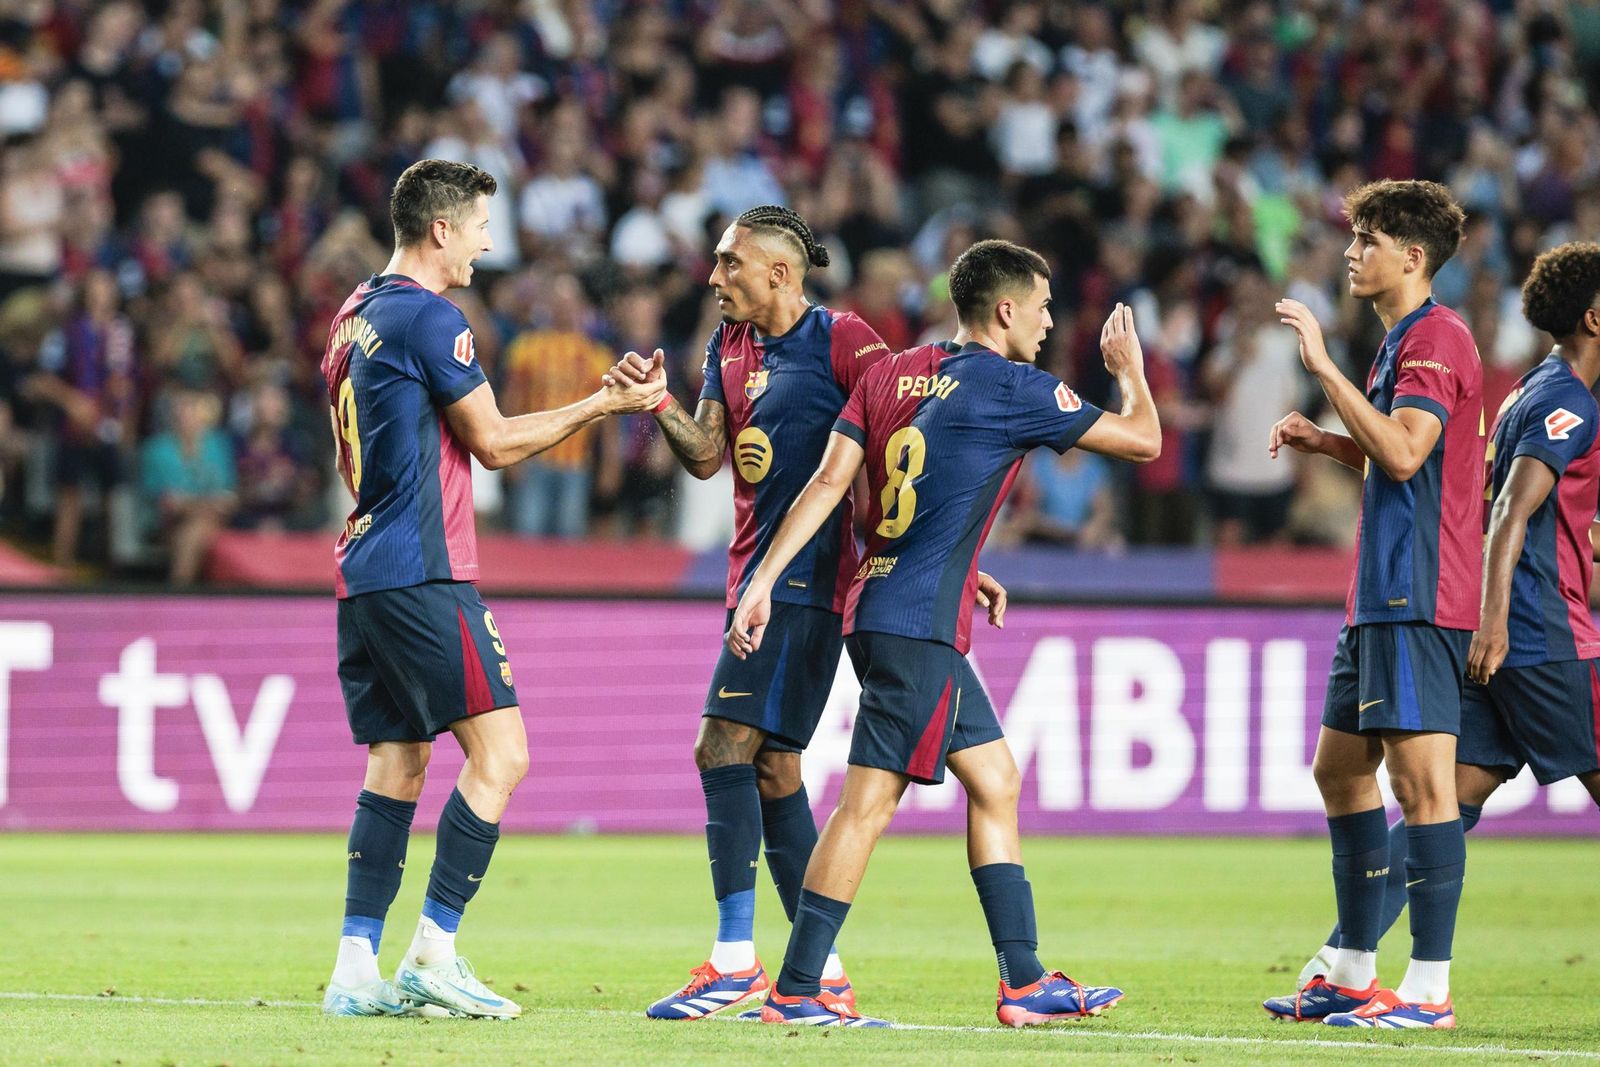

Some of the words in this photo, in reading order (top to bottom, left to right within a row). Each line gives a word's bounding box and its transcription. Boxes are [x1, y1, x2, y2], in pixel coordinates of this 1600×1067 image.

[897, 375, 960, 401] PEDRI
[1401, 360, 1443, 370] AMBILIGHT
[1443, 366, 1452, 374] tv
[338, 377, 362, 493] 9
[875, 426, 926, 539] 8
[483, 610, 506, 656] 9
[98, 636, 296, 814] tv
